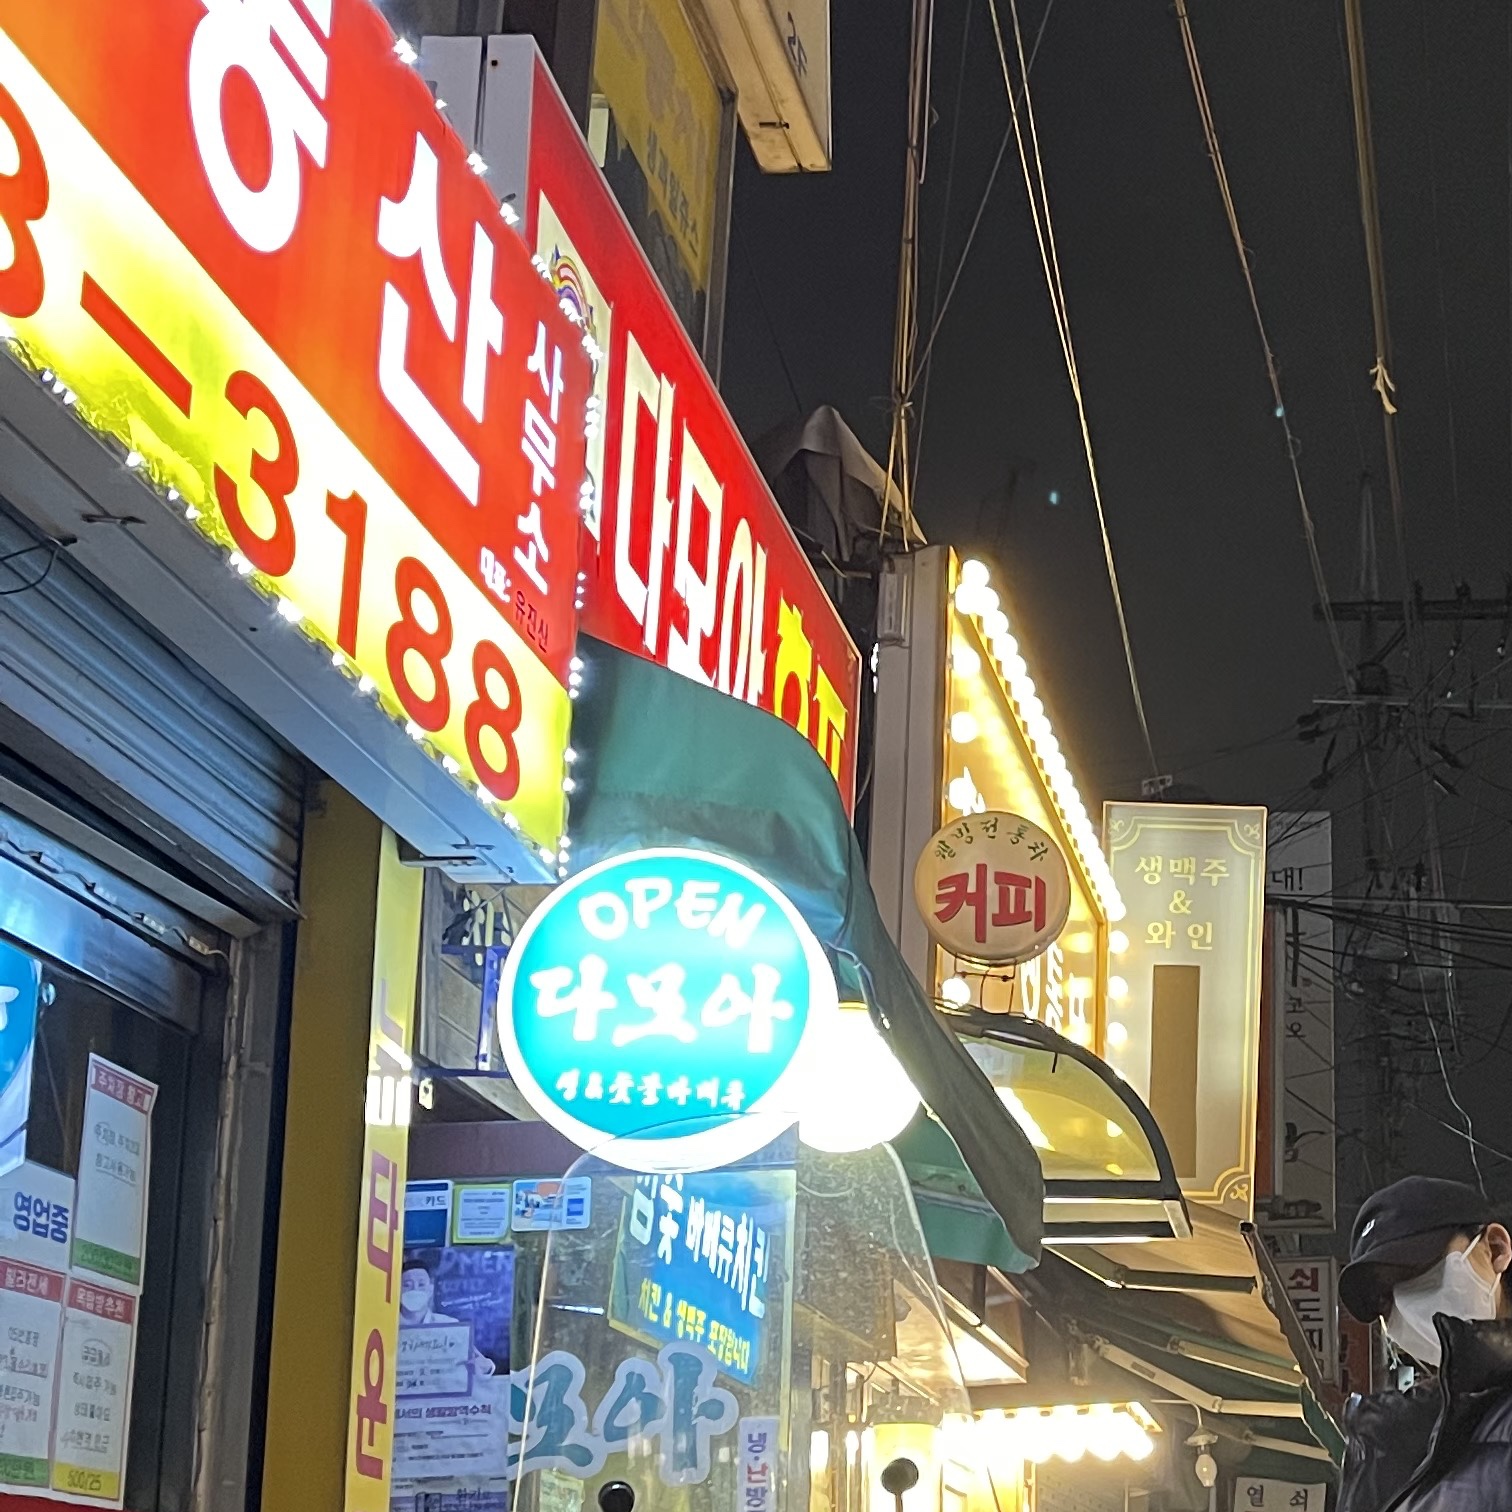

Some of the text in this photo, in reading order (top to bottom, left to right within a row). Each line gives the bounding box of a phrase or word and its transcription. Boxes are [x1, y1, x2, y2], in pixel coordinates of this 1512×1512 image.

[513, 320, 564, 596] 사무소
[614, 328, 768, 708] 다모아
[1134, 854, 1233, 888] 생맥주
[578, 876, 768, 949] OPEN
[933, 862, 1048, 945] 커피
[1167, 888, 1194, 917] &
[1143, 919, 1215, 953] 와인
[528, 953, 796, 1054] 다모아
[13, 1190, 71, 1246] 영업중
[637, 1277, 662, 1324] 치킨
[66, 1469, 104, 1493] 500/25
[1246, 1483, 1309, 1512] 열쇠
